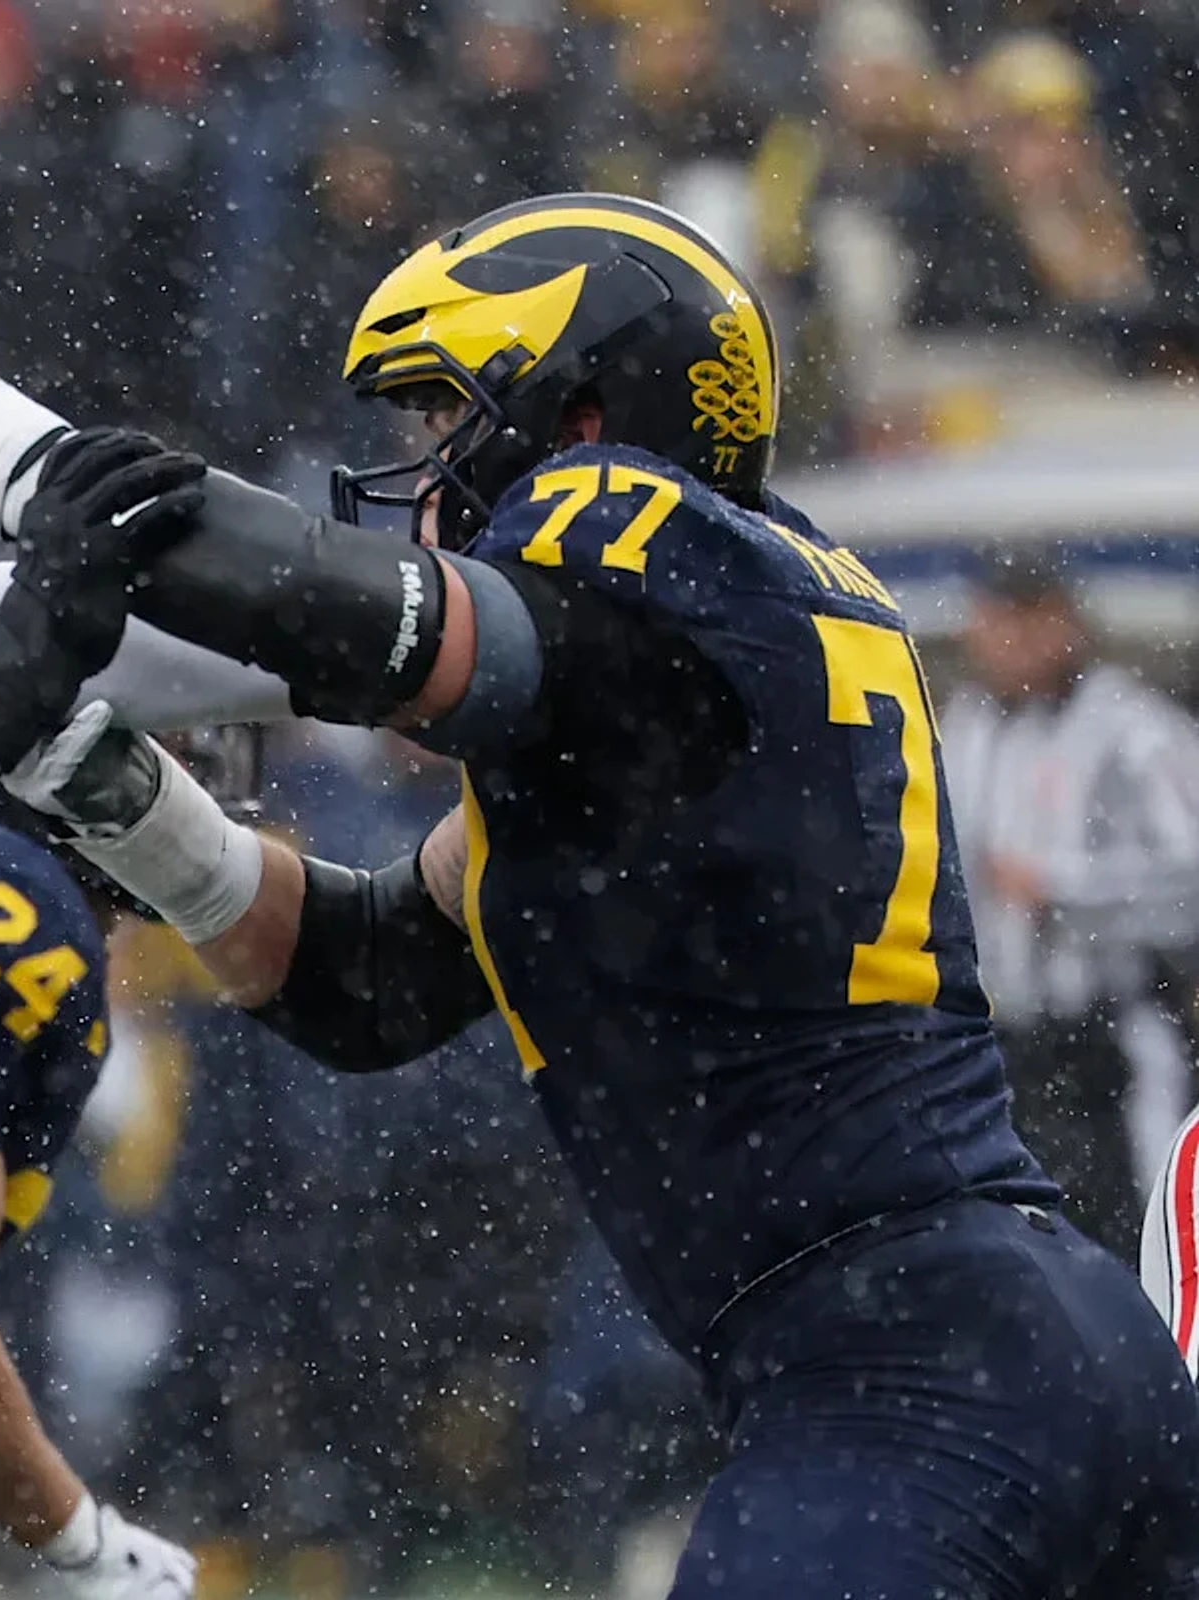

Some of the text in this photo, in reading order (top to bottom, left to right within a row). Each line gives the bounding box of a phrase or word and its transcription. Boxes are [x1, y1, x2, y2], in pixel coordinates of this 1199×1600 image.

[713, 446, 739, 475] 77
[521, 465, 681, 575] 77
[387, 570, 424, 673] Mueller
